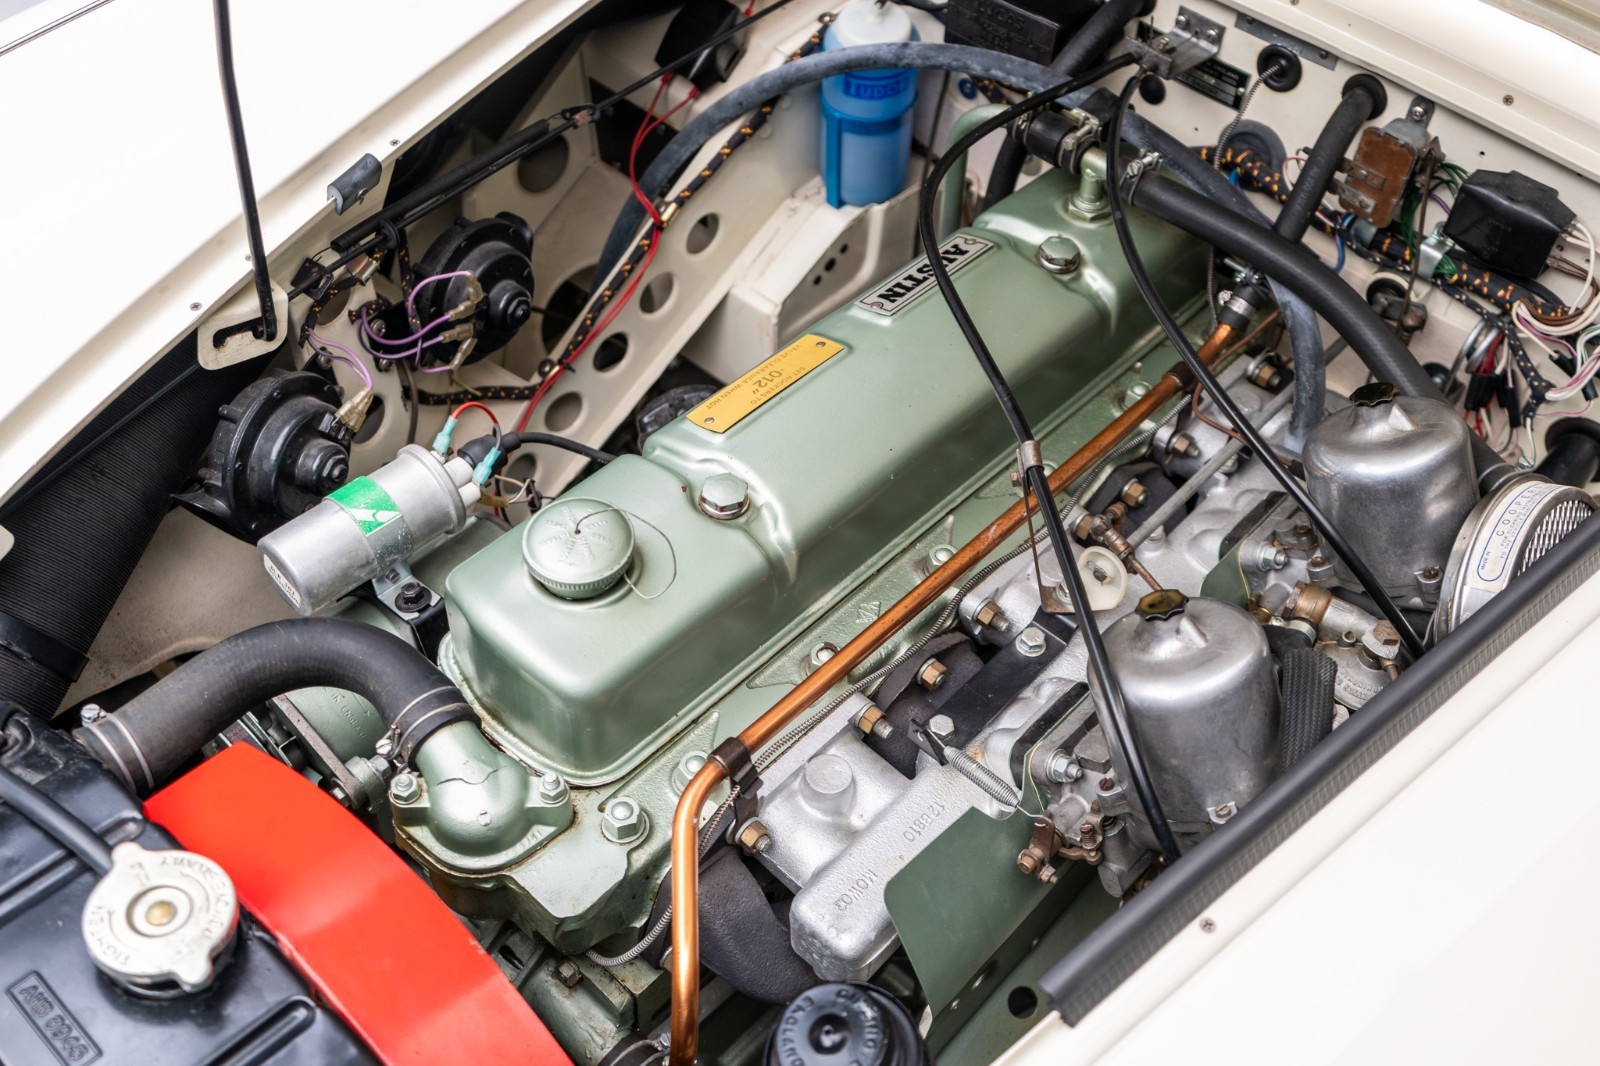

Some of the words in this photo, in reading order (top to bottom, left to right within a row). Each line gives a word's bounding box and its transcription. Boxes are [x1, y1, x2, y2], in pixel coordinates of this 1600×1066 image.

[782, 344, 802, 359] VALVE
[744, 356, 783, 384] CLEARANCE
[792, 366, 806, 377] SET
[721, 382, 743, 400] WHEN
[761, 375, 794, 398] ROCKERS
[706, 397, 722, 410] HOT
[750, 396, 762, 405] TO
[1480, 557, 1488, 571] MADE
[902, 801, 945, 843] 12B810
